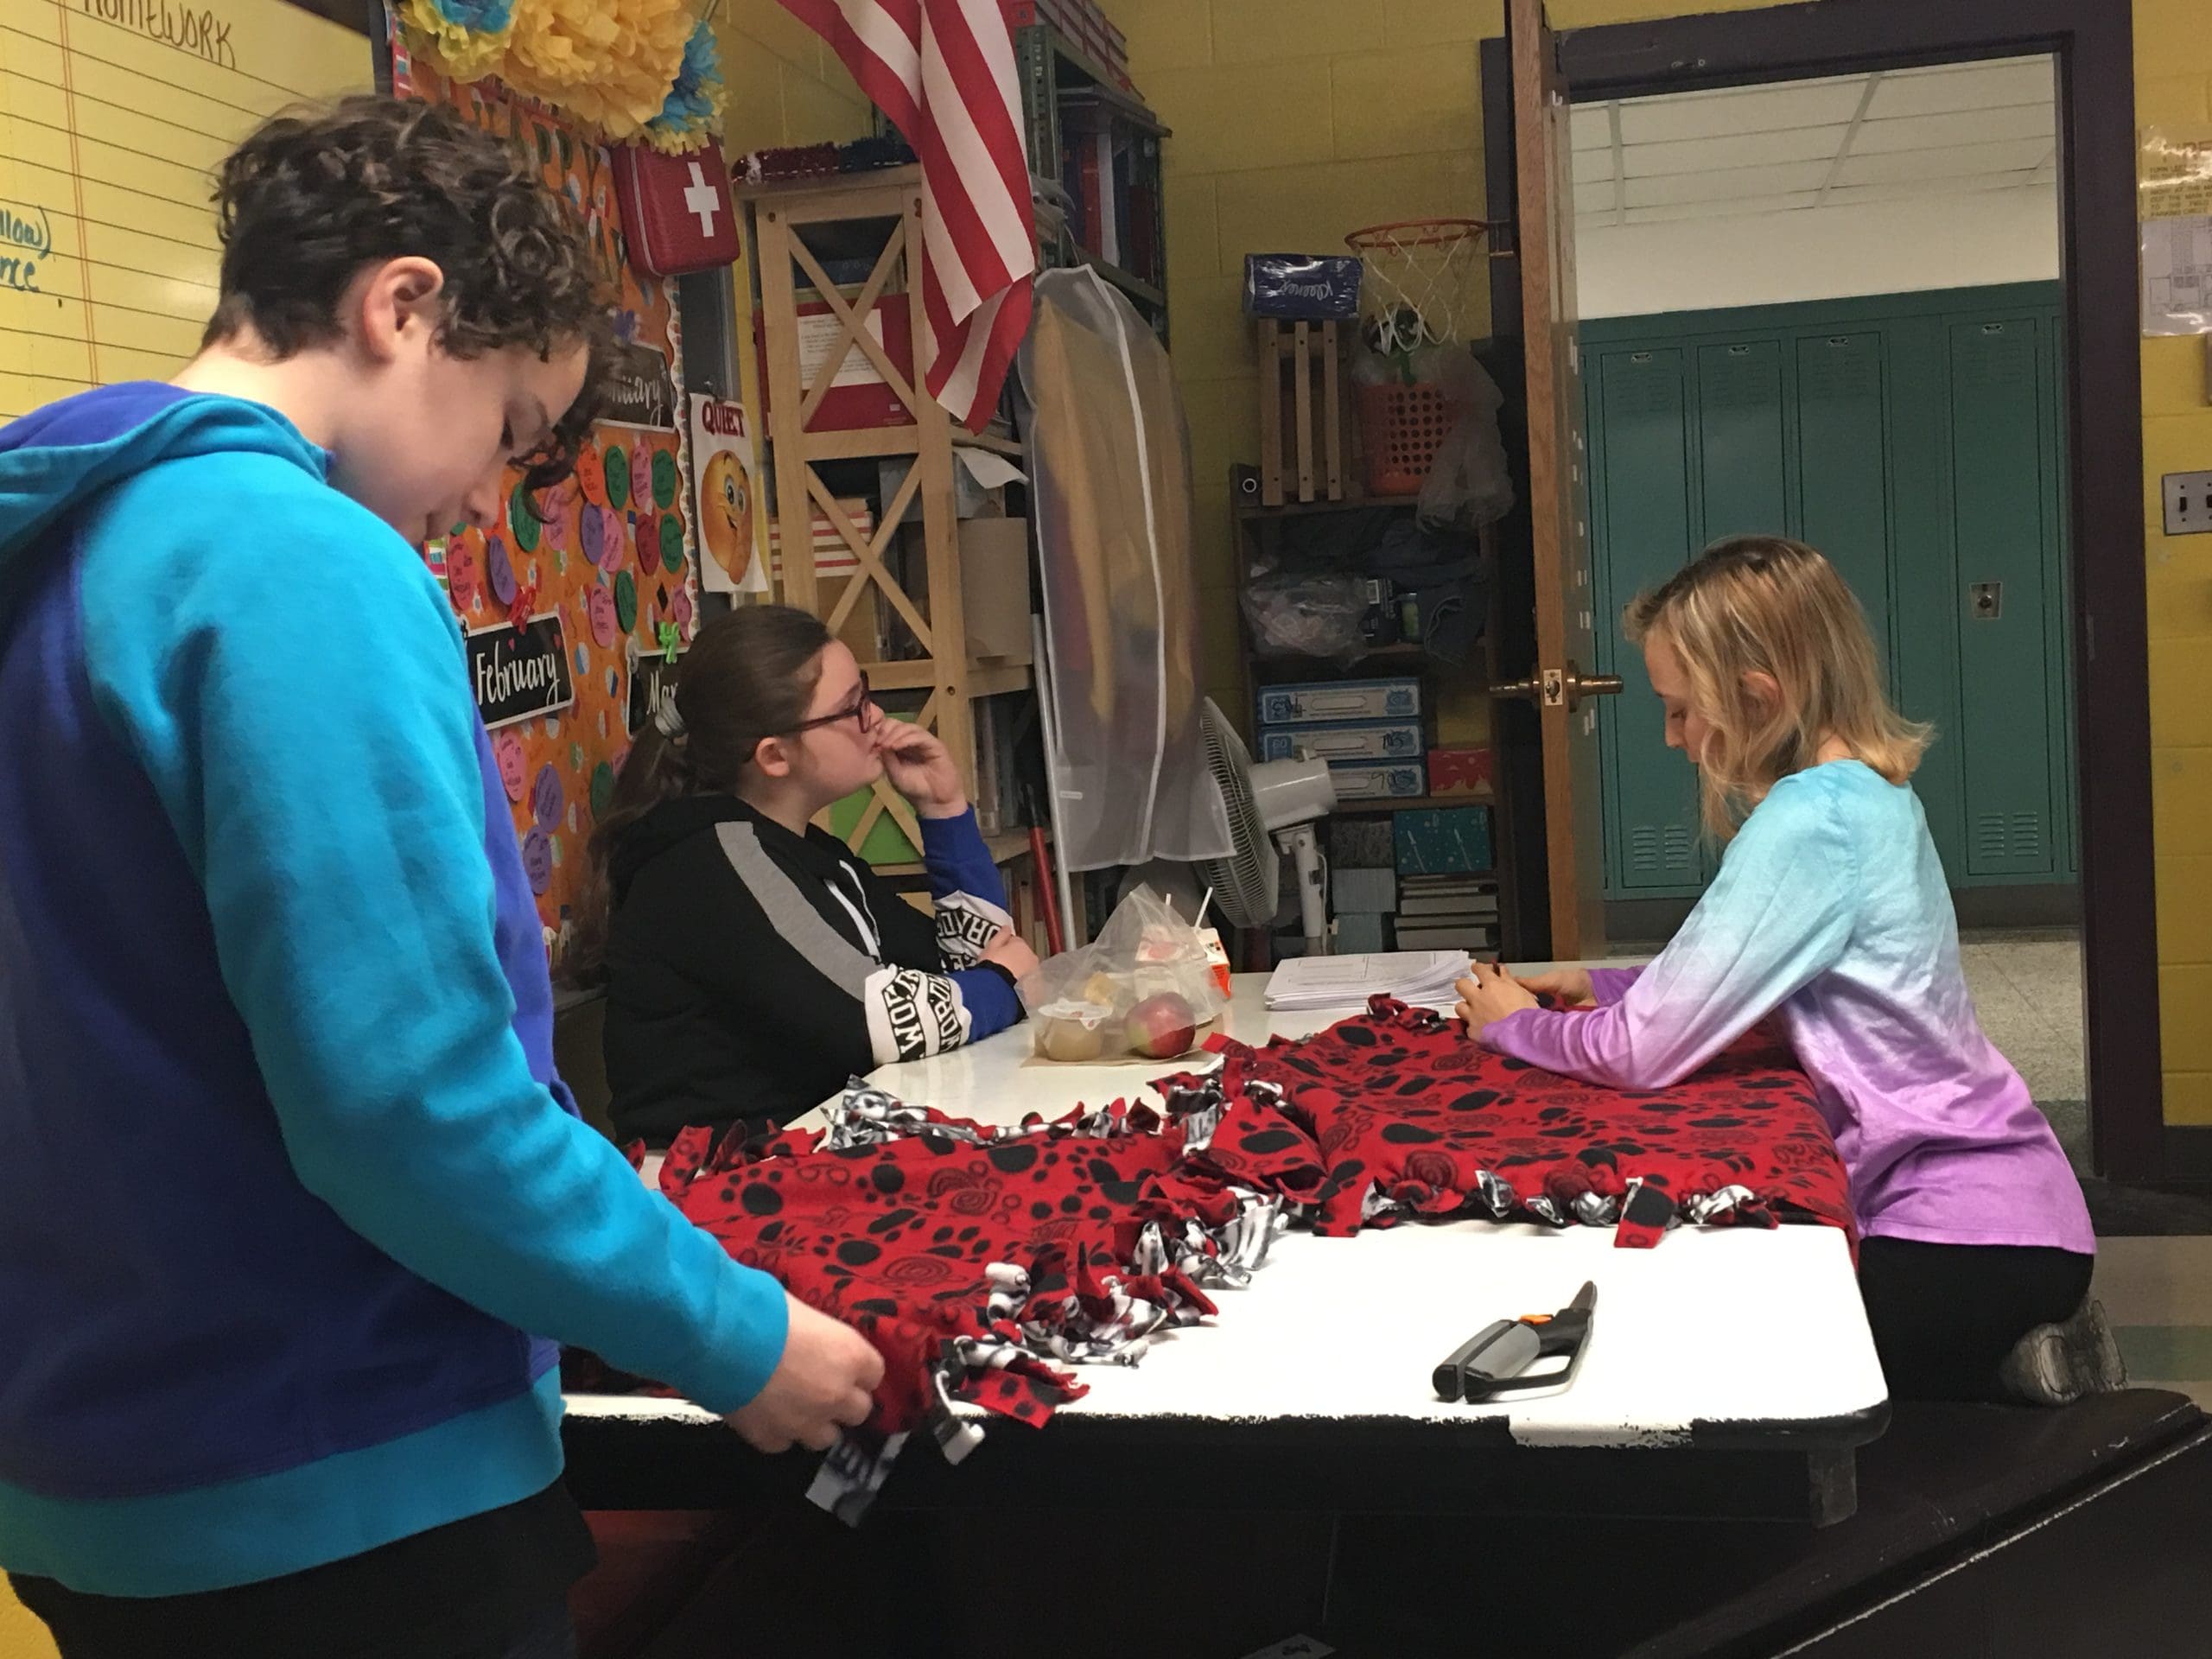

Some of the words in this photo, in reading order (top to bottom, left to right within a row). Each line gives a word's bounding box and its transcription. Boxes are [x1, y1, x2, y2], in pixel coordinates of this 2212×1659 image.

[1280, 279, 1333, 302] Kleenex
[702, 401, 745, 437] QUIET
[476, 640, 560, 707] February
[646, 670, 678, 715] Mar
